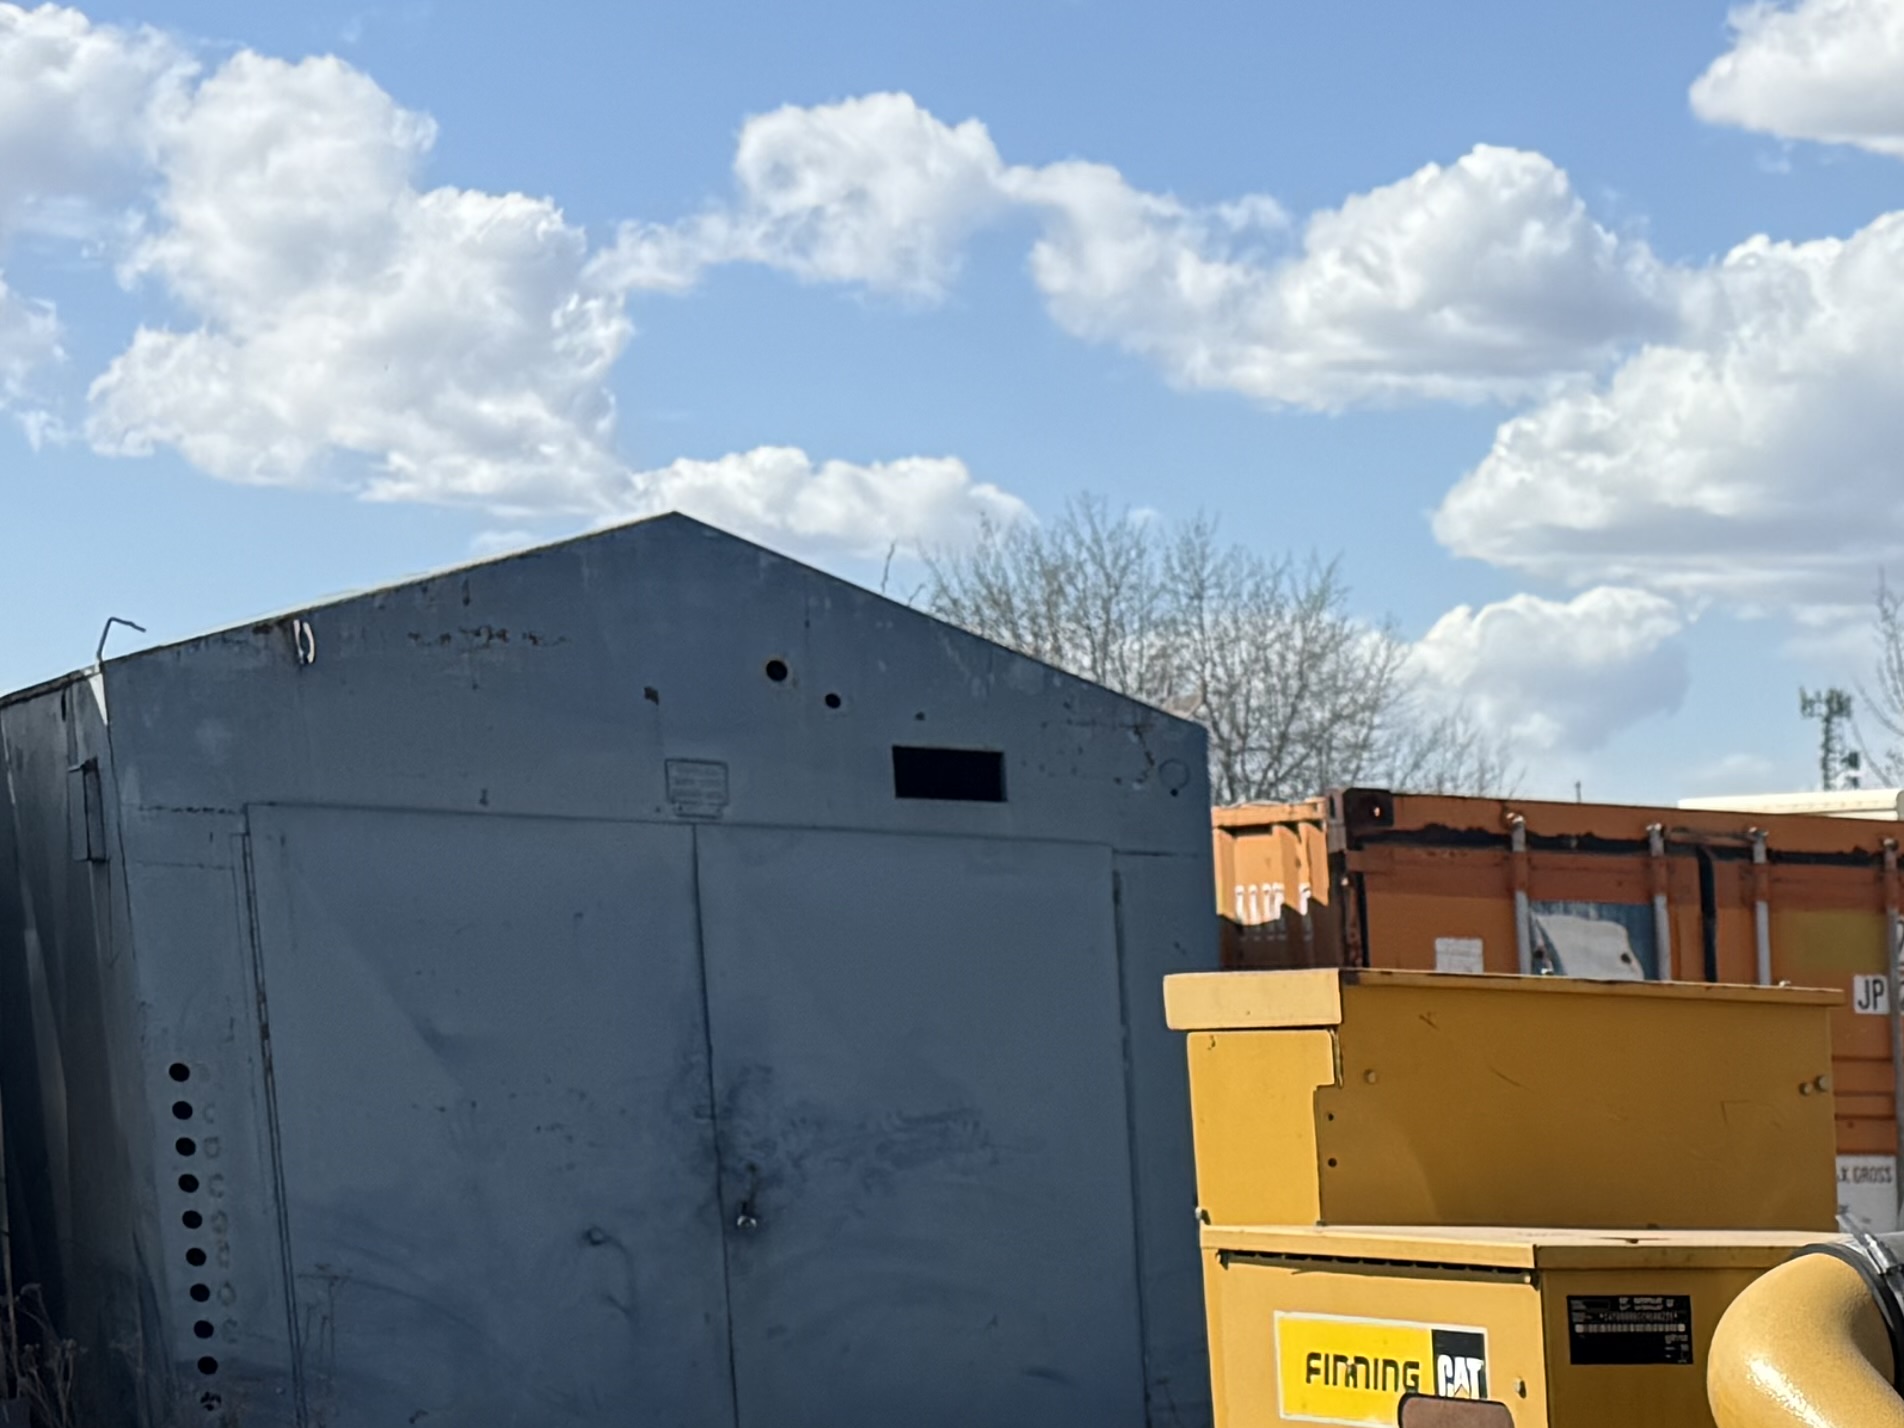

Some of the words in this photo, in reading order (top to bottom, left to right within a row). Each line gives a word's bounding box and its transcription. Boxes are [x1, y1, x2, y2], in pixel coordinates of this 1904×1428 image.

[1857, 979, 1885, 1010] JP
[1306, 1352, 1420, 1394] FINNING
[1437, 1354, 1485, 1399] CAT
